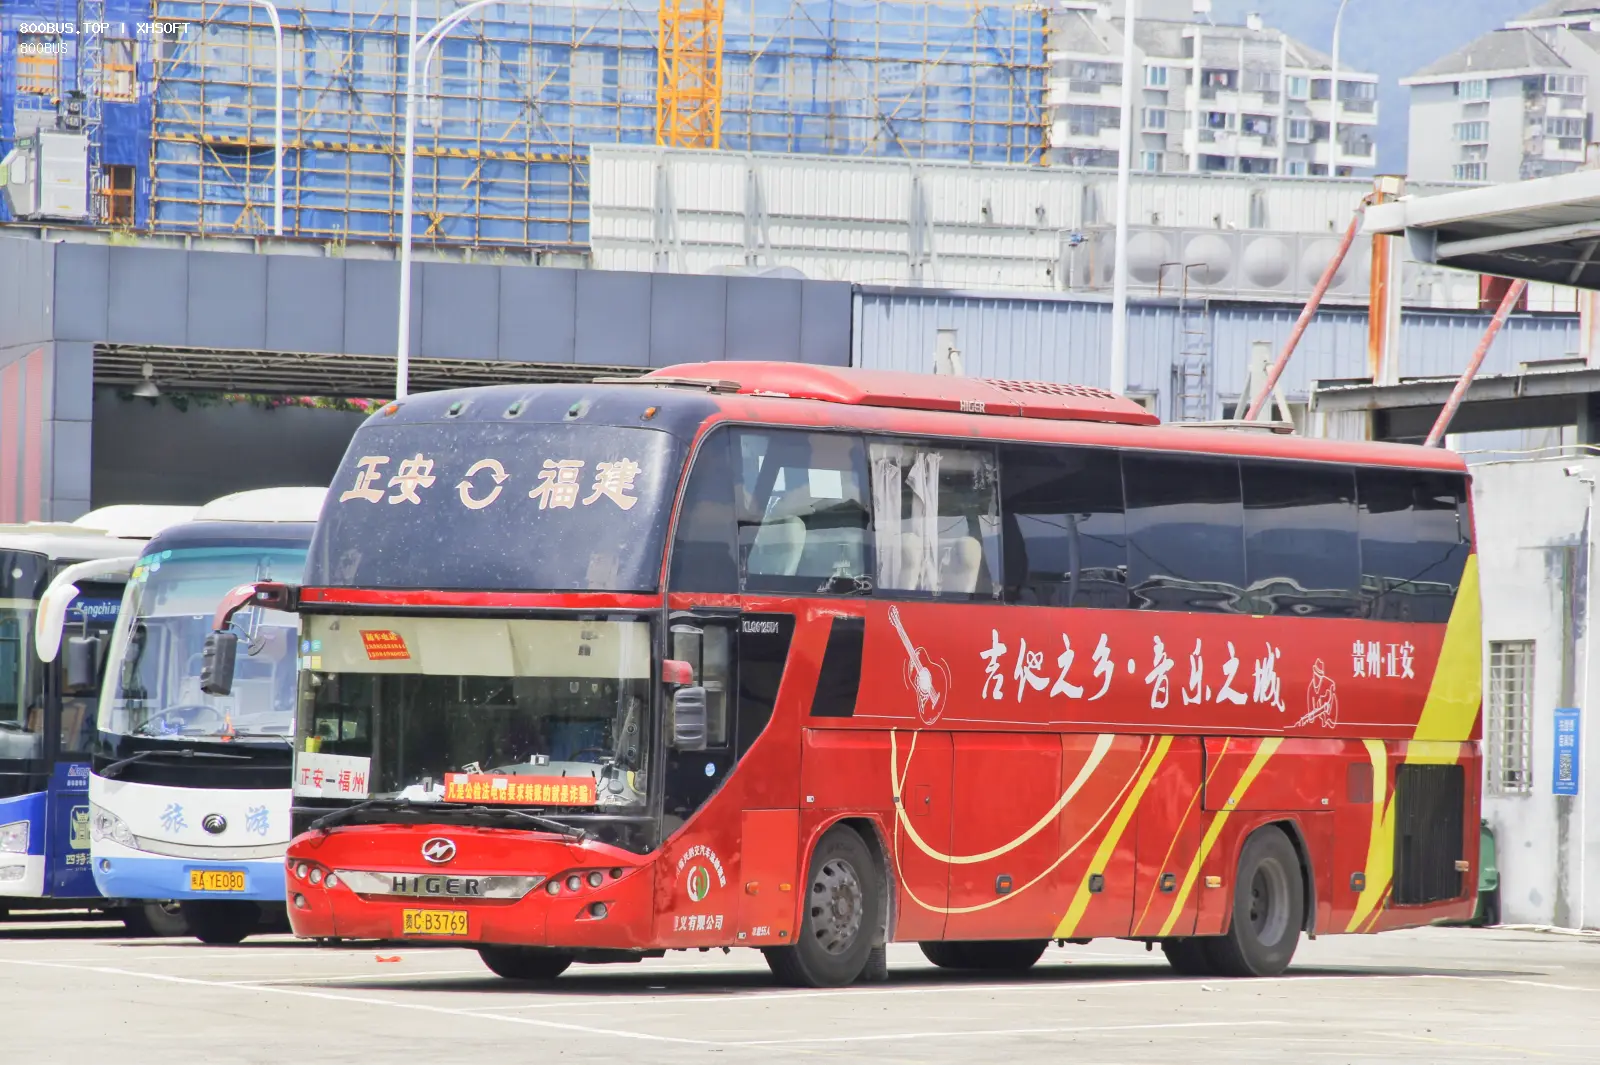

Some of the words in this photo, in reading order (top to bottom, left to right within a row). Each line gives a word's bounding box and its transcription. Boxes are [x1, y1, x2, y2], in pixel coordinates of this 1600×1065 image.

[959, 399, 985, 413] HIGER
[339, 453, 436, 505] 正安
[529, 457, 642, 510] 福建
[391, 876, 480, 895] HIGER
